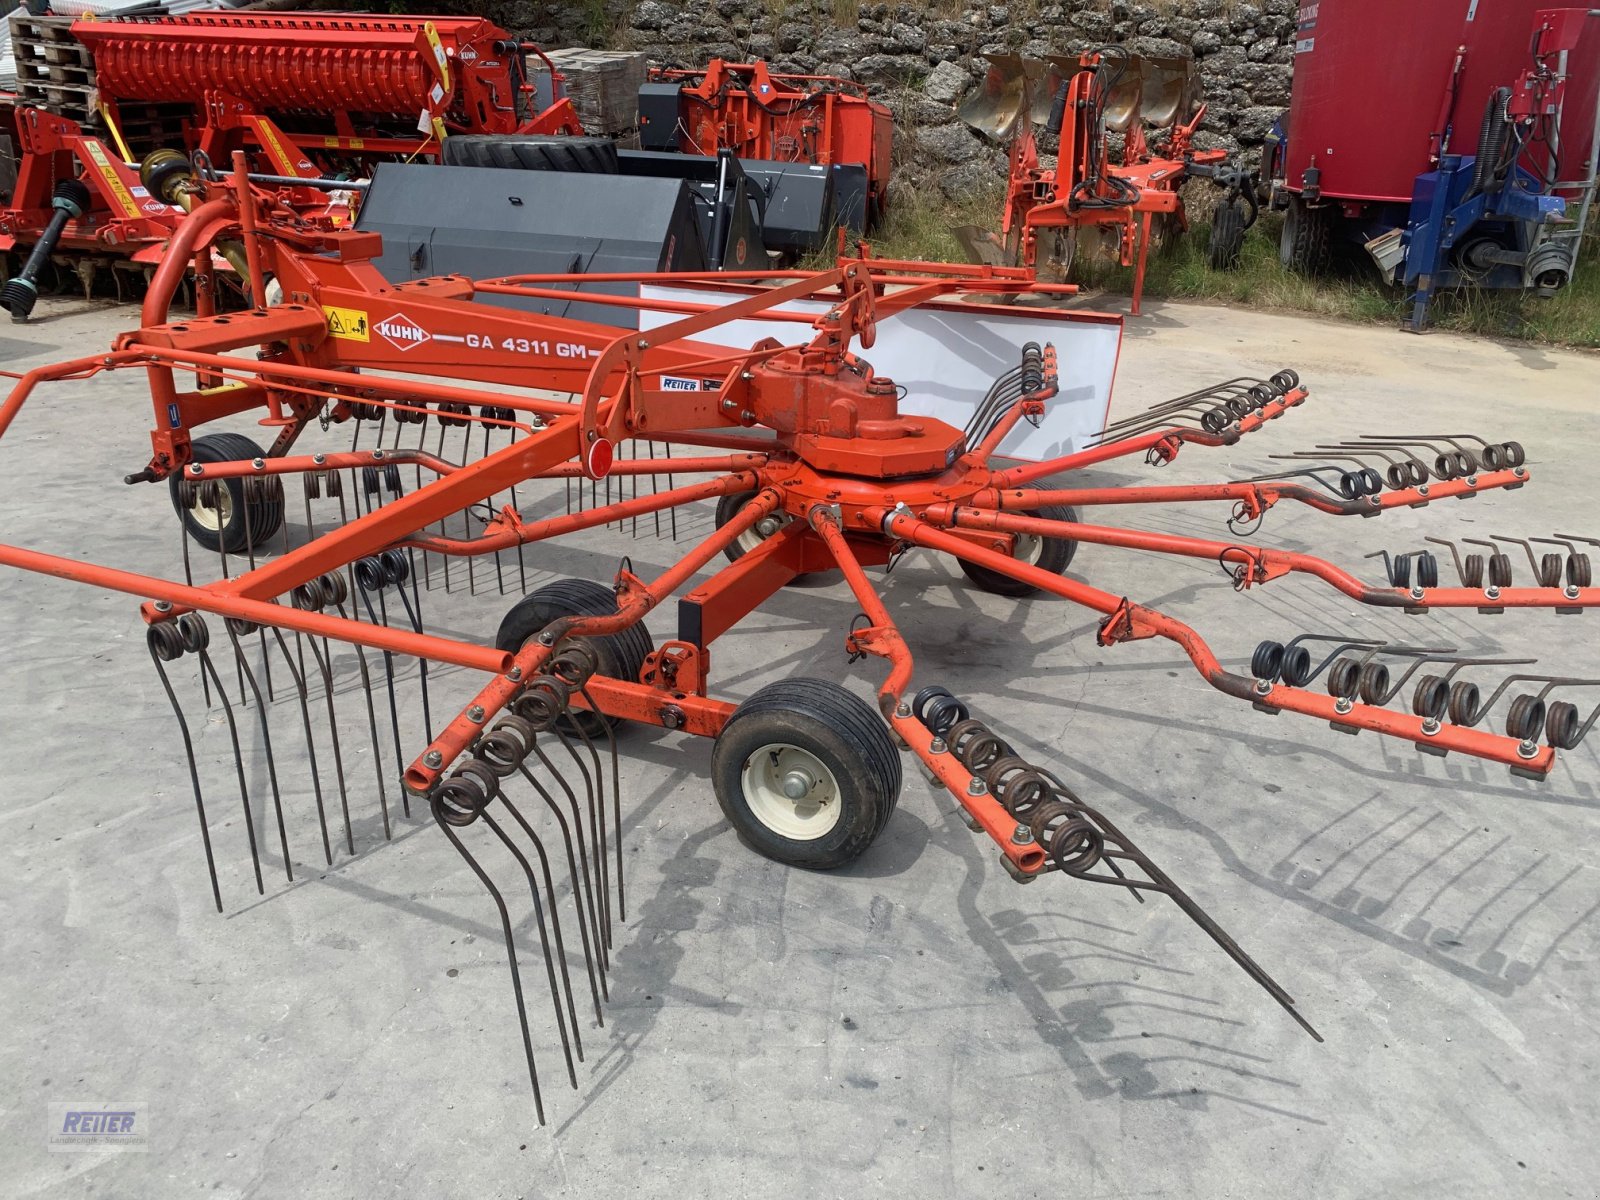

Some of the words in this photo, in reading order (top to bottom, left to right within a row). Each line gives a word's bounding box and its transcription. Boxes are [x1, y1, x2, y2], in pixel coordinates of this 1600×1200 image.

[460, 52, 476, 60] KUHN
[145, 203, 166, 211] KUHN
[380, 322, 423, 342] KUHN
[466, 334, 494, 349] GA
[502, 338, 549, 355] 4311
[556, 342, 586, 359] GM
[663, 378, 697, 391] REITER
